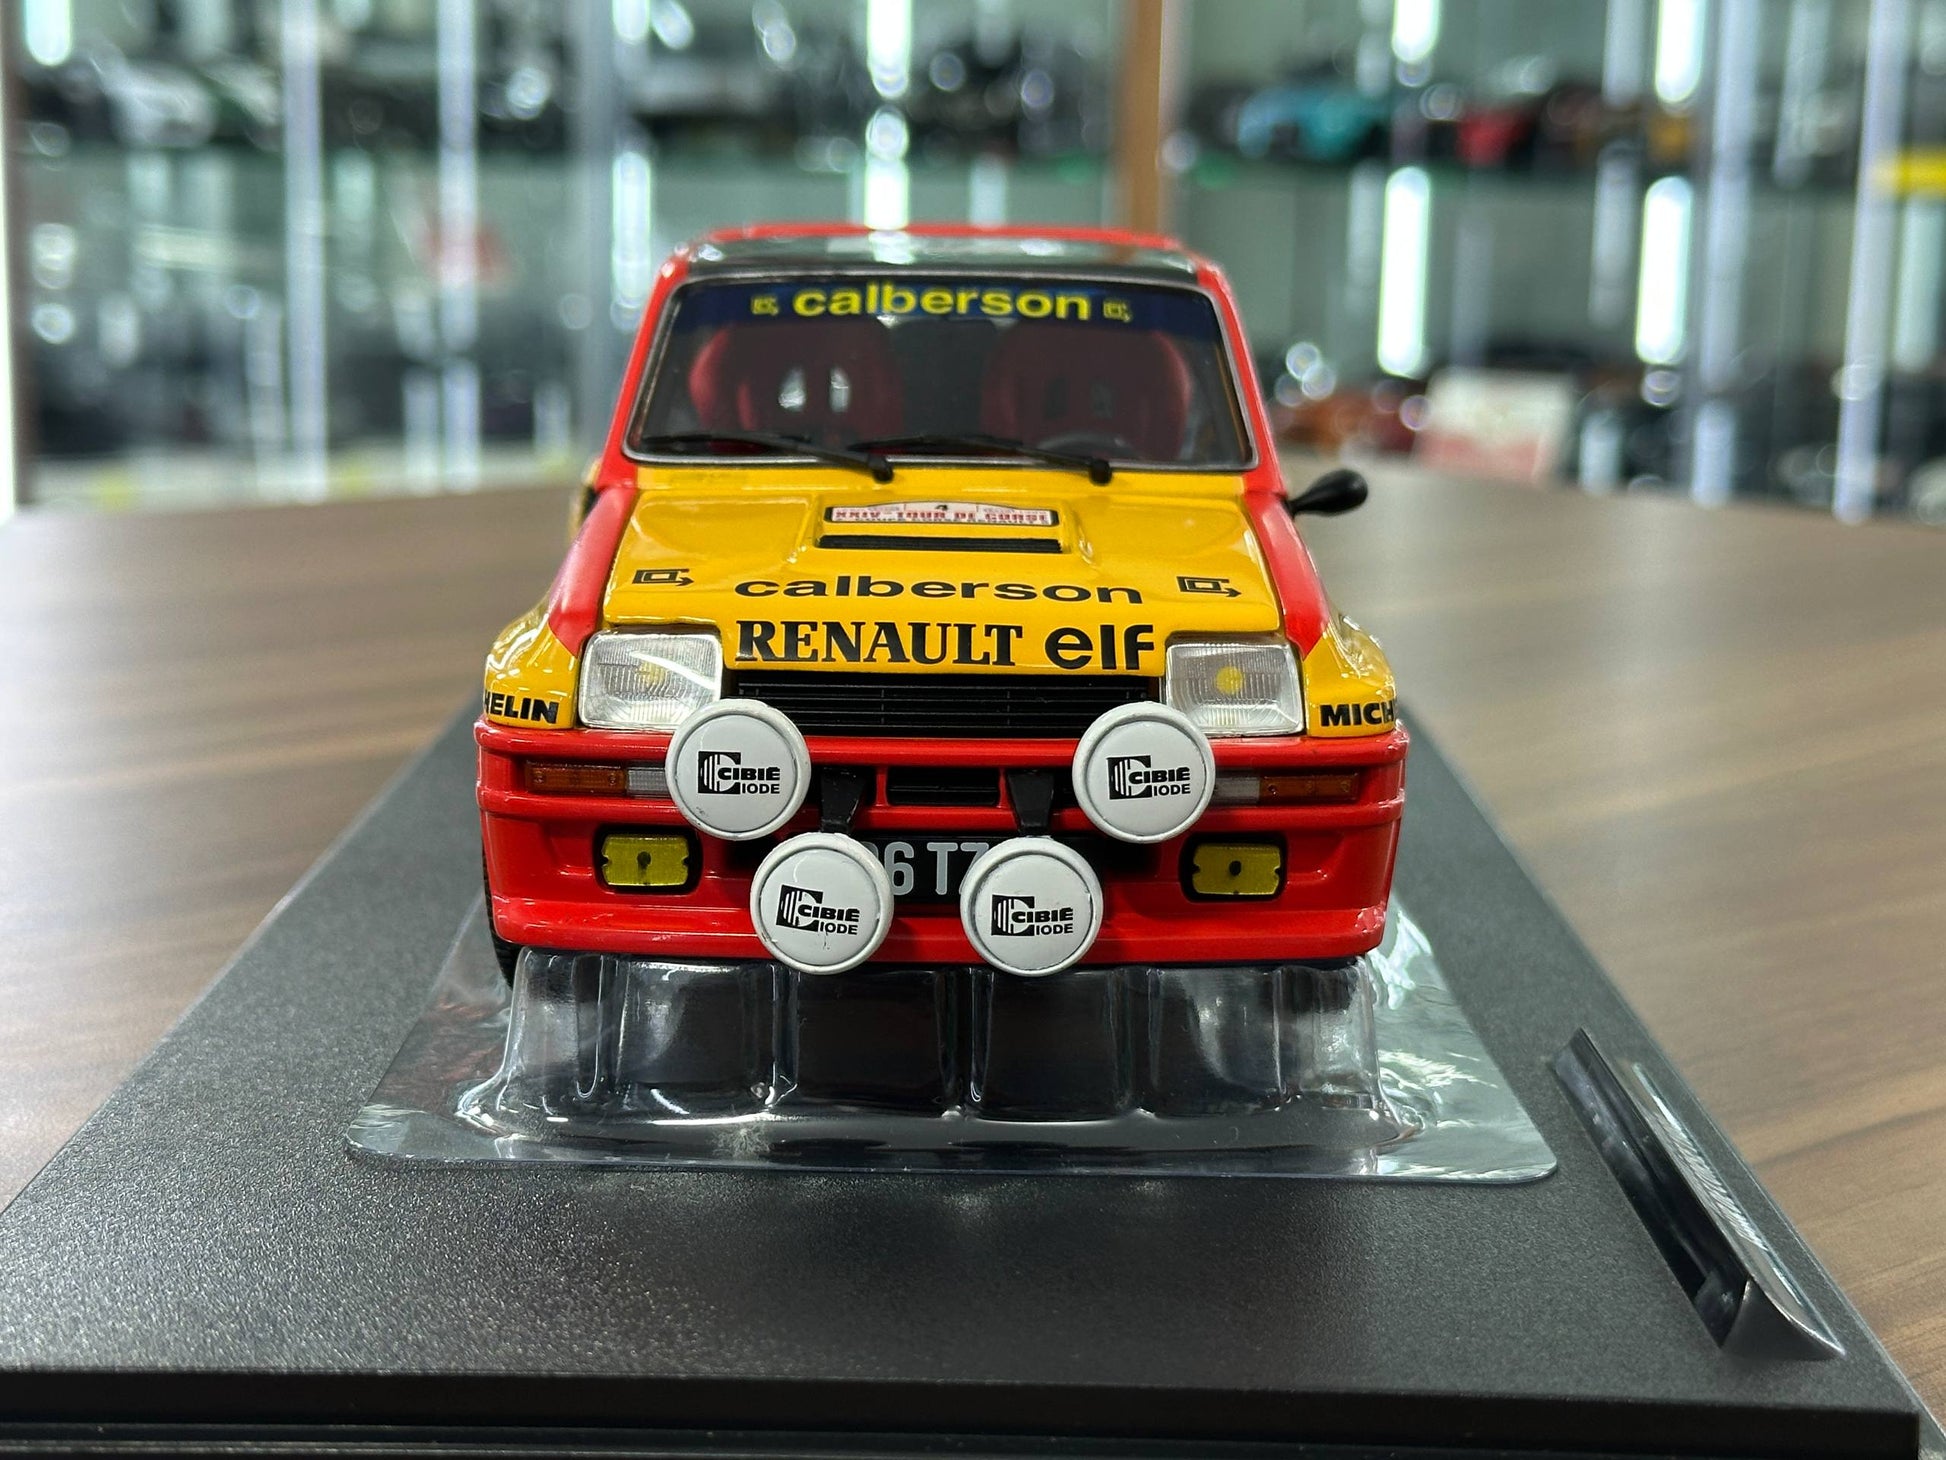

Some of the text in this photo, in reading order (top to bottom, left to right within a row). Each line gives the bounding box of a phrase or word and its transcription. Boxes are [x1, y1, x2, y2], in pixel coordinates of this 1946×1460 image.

[793, 282, 1091, 320] calberson
[735, 576, 1143, 604] calberson
[735, 620, 1155, 670] RENAULT elf
[742, 783, 780, 794] IODE
[1154, 784, 1192, 797] IODE
[820, 922, 859, 936] IODE
[1036, 923, 1074, 936] IODE
